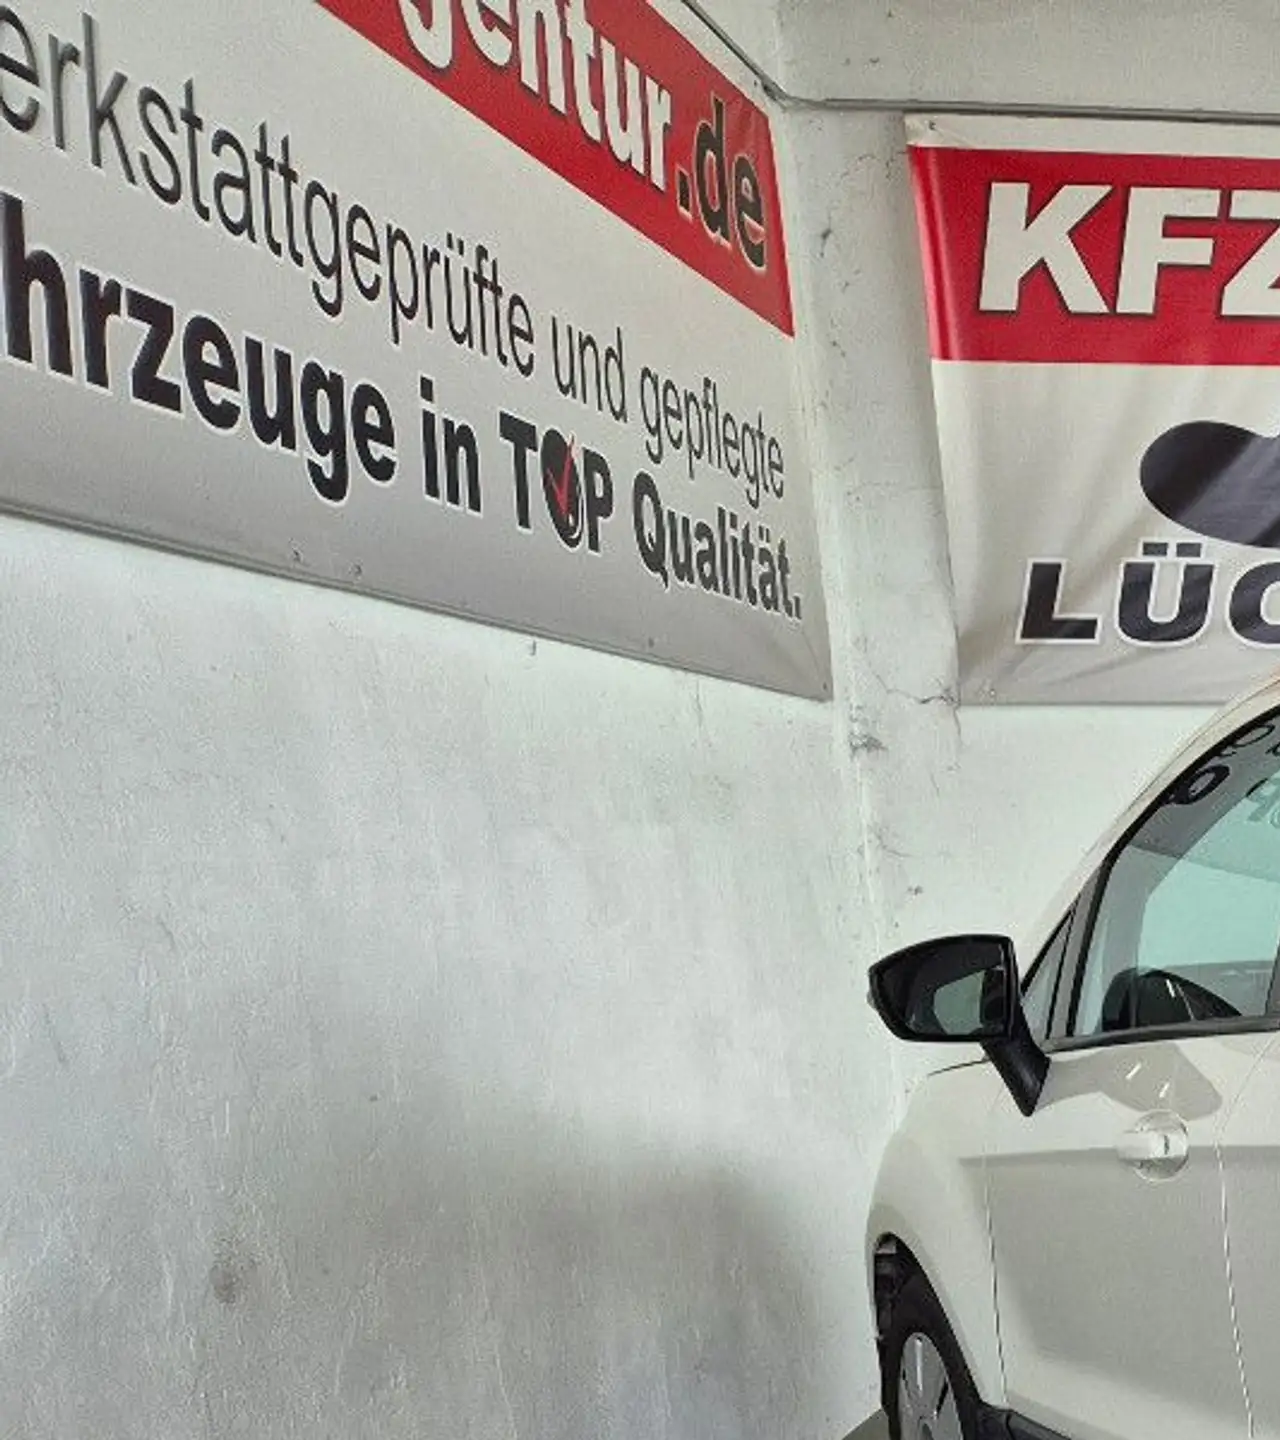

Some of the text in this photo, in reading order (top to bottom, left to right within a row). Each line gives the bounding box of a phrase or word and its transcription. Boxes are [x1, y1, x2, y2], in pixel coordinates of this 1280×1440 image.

[1, 192, 801, 619] hrzeuge in TOP Qualität.
[552, 316, 627, 425] und
[639, 366, 785, 509] gepflegte
